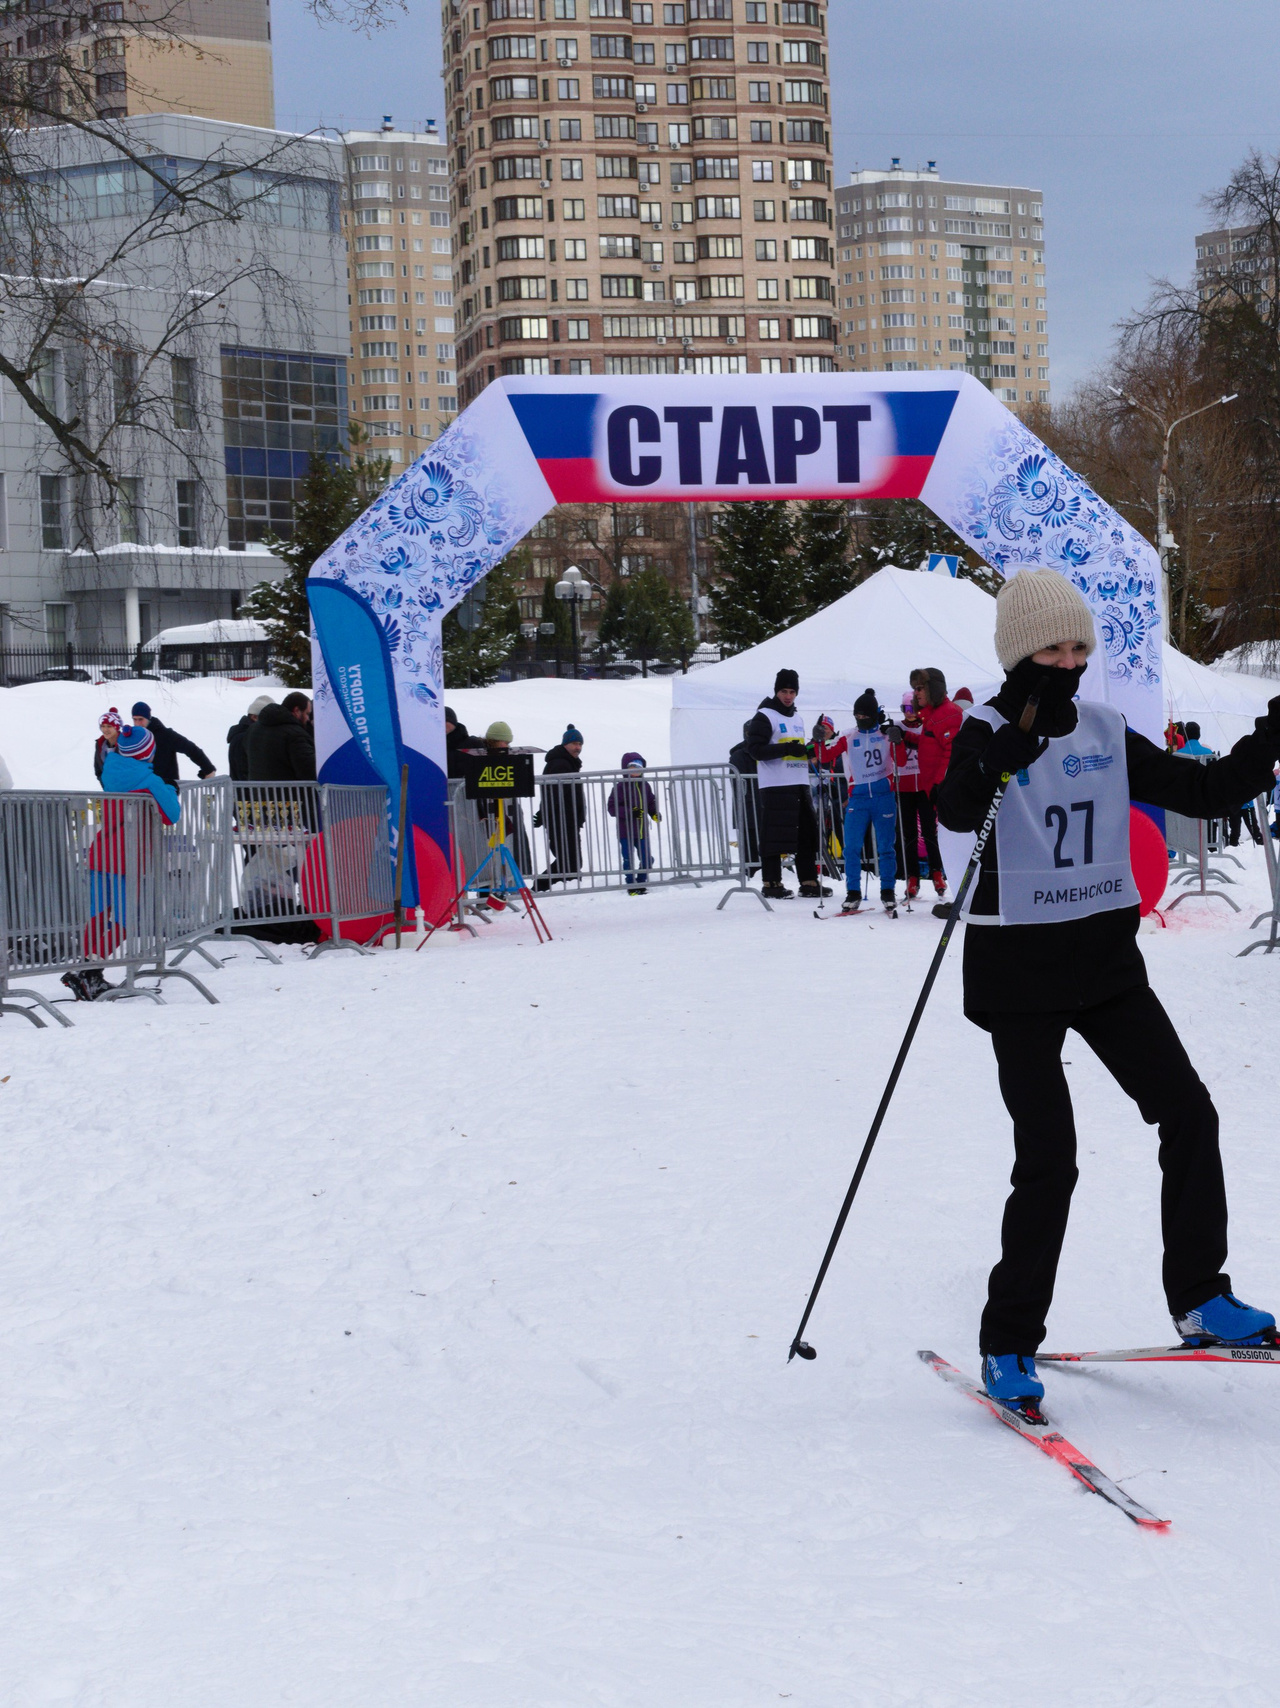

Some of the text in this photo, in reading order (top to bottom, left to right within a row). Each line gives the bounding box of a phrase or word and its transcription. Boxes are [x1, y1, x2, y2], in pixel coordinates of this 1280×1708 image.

[607, 405, 872, 486] СТАРТ
[864, 749, 883, 768] 29
[479, 766, 514, 781] ALGE
[971, 787, 1004, 863] NORDWAY
[1044, 800, 1094, 869] 27
[1034, 879, 1123, 904] РАМЕНСКОЕ
[1231, 1350, 1275, 1361] ROSSIGNOL
